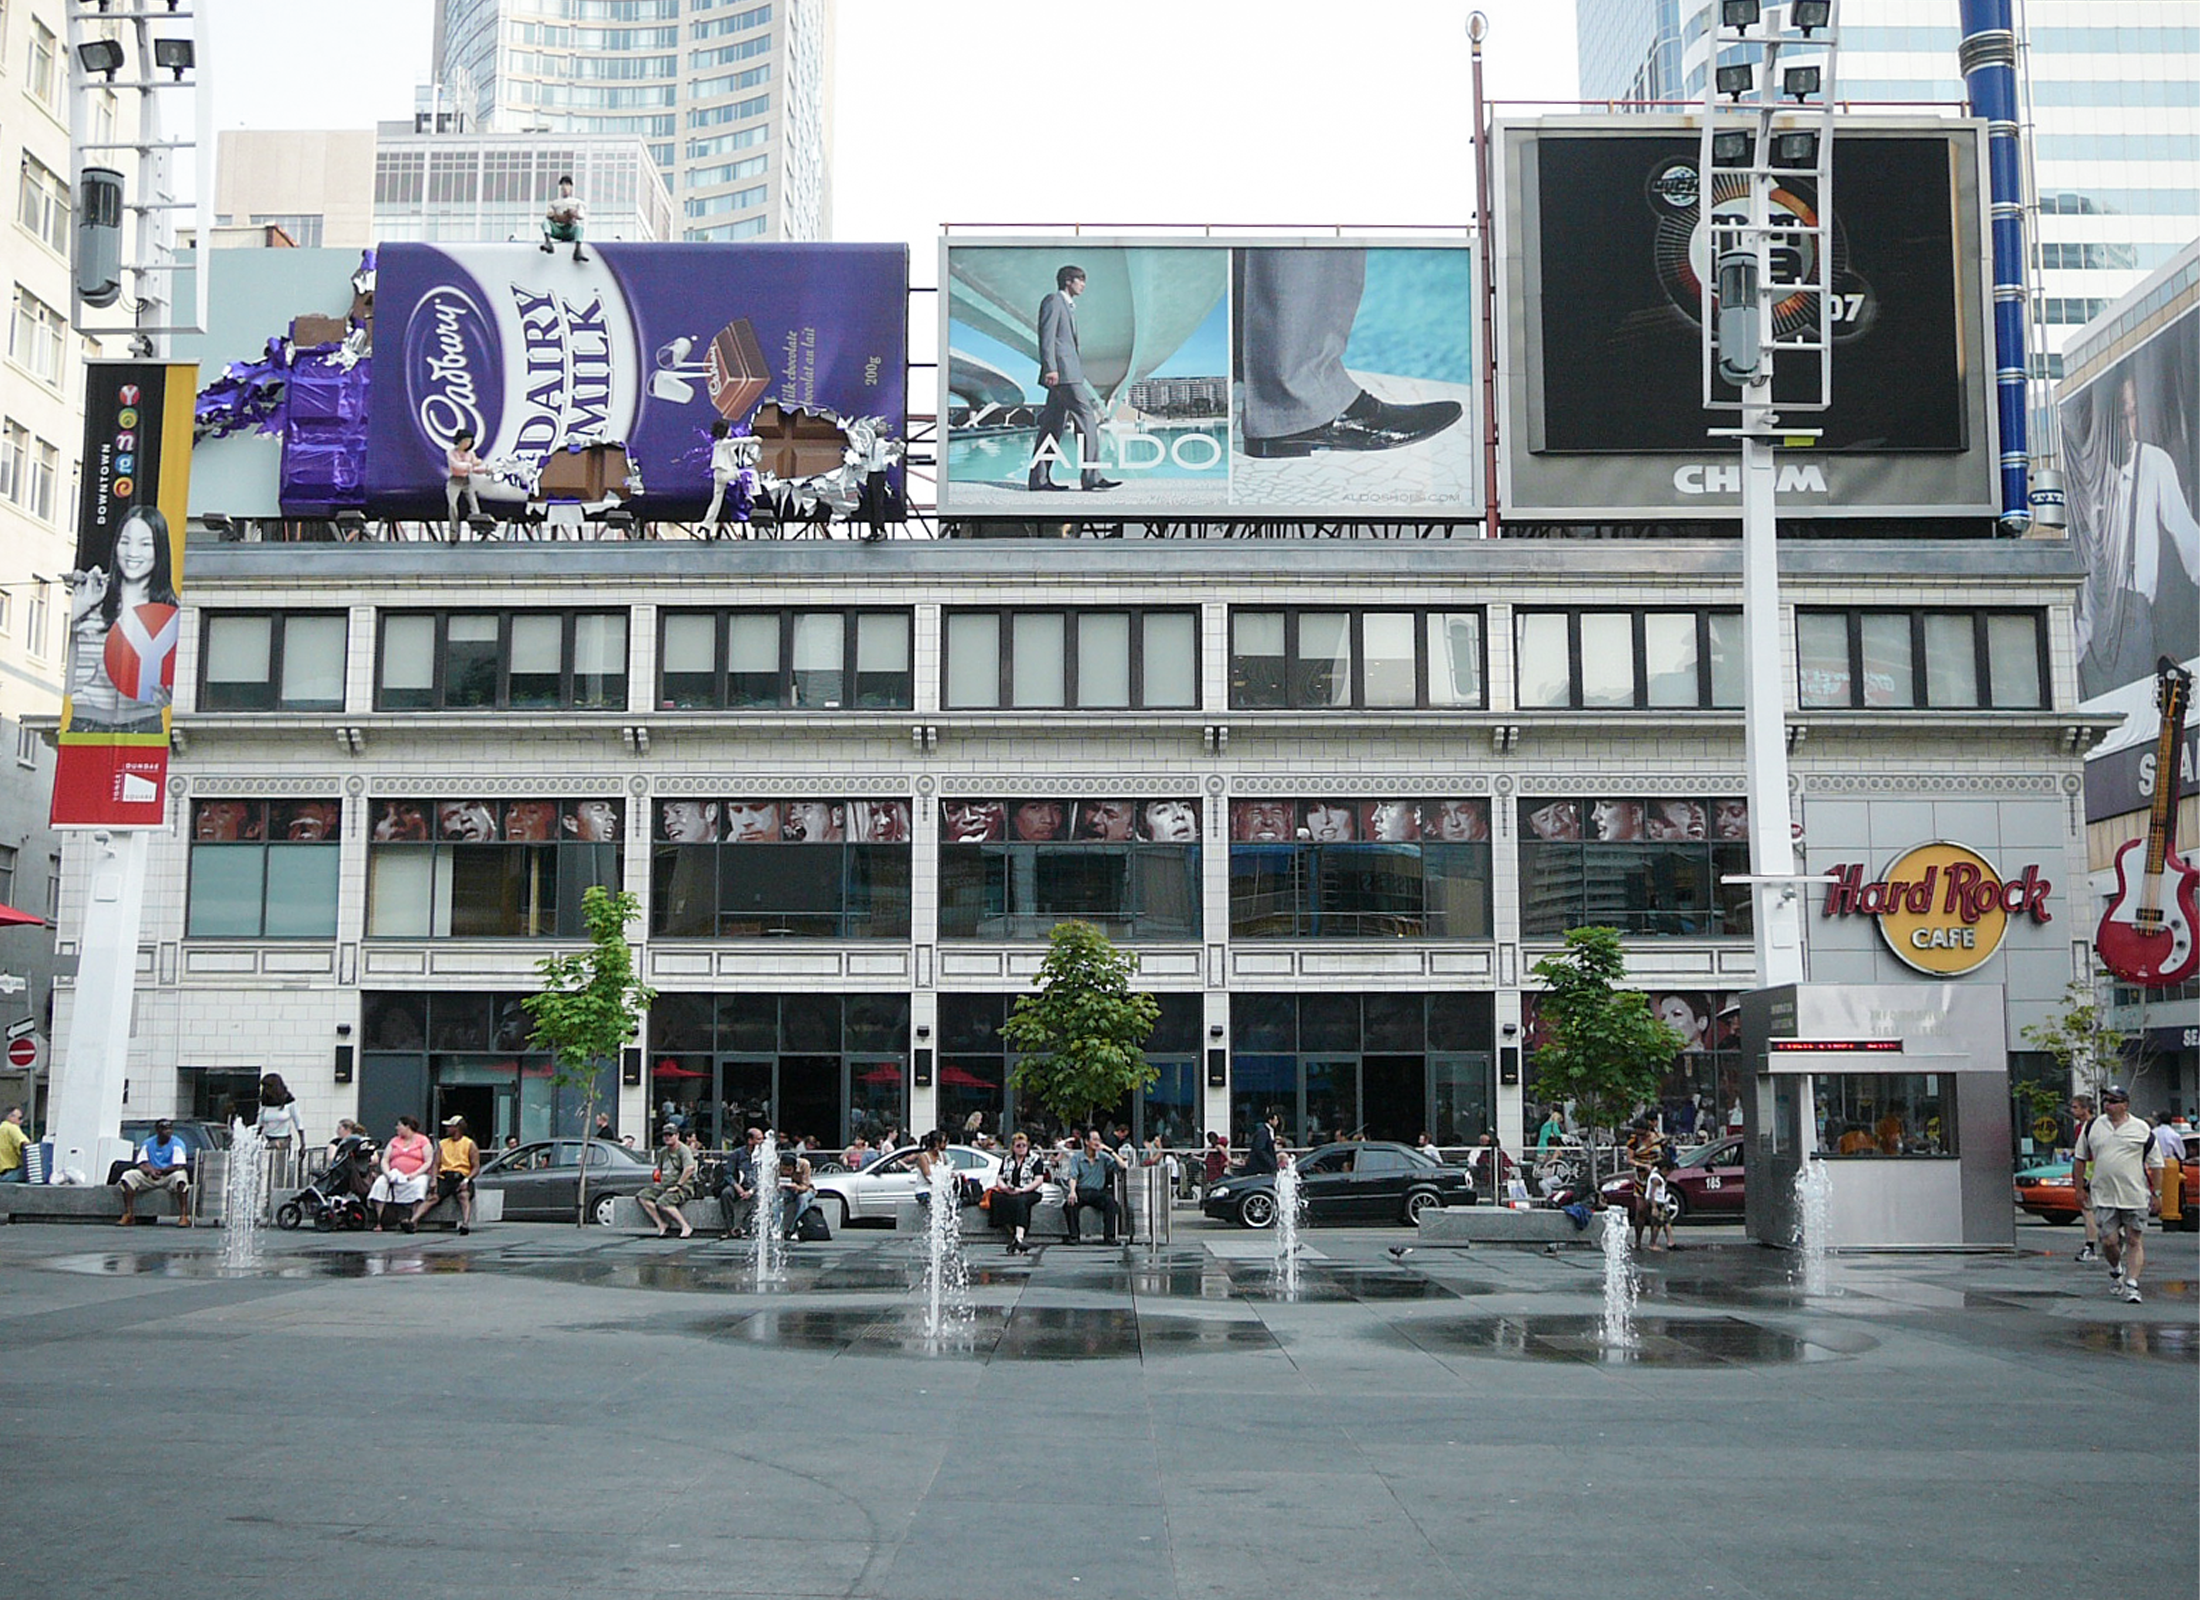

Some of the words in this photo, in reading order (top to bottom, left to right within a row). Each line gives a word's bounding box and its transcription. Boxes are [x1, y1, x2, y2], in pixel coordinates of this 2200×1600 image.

[421, 304, 485, 455] Cadbury
[510, 284, 567, 456] DAIRY
[562, 296, 611, 438] MILK
[781, 382, 797, 405] ilk
[865, 357, 881, 386] 200g
[1028, 433, 1222, 470] ALDO
[1673, 465, 1828, 494] CHM
[97, 444, 111, 525] DOWNTOWN
[2138, 738, 2200, 796] SA
[1825, 864, 1938, 915] Hard
[1943, 862, 2052, 923] Rock
[1911, 928, 1976, 949] CAFE
